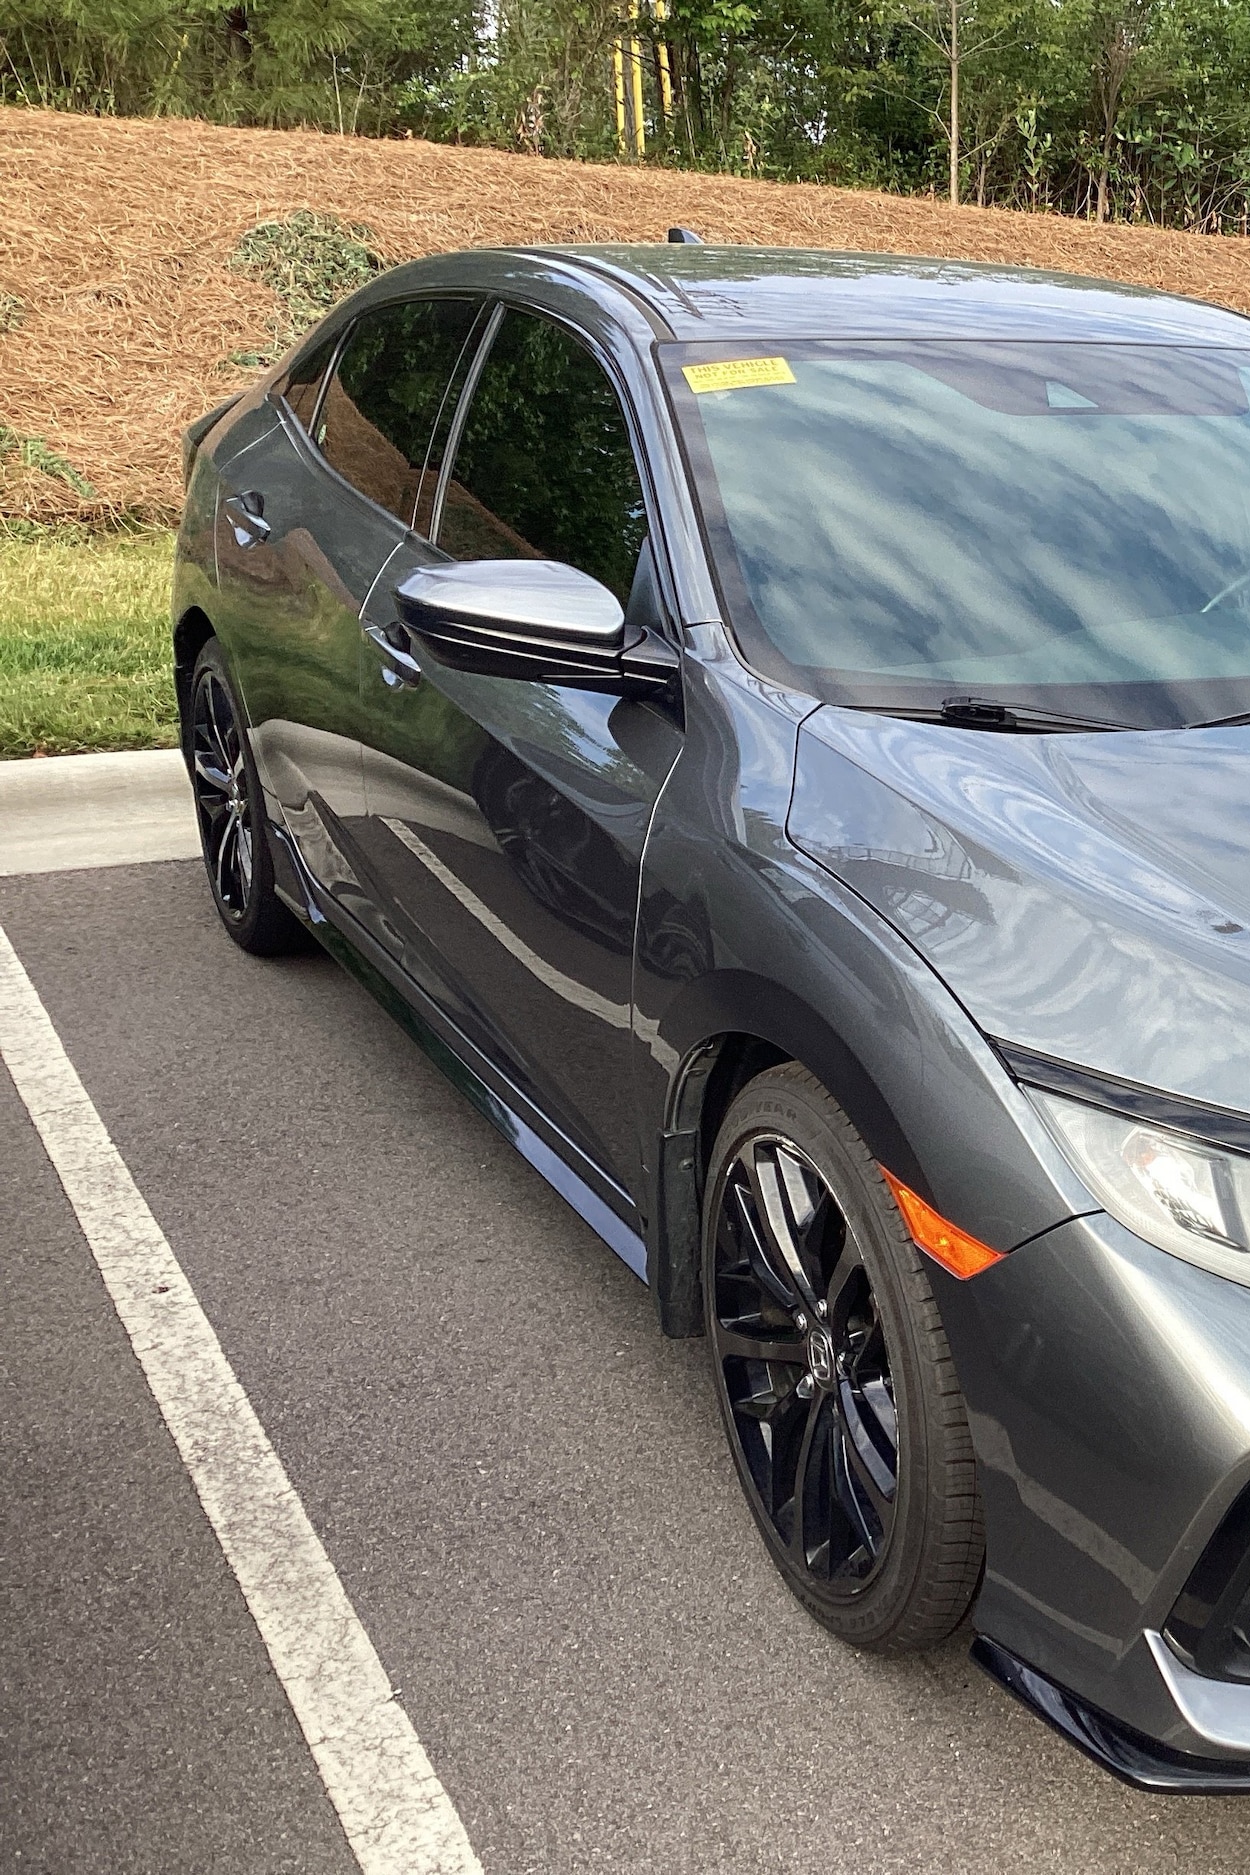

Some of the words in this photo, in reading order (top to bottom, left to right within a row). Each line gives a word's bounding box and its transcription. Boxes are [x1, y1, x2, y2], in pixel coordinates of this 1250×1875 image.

[690, 364, 720, 374] THIS
[722, 359, 778, 371] VEHICLE
[695, 370, 718, 380] NOT
[749, 366, 778, 375] SALE
